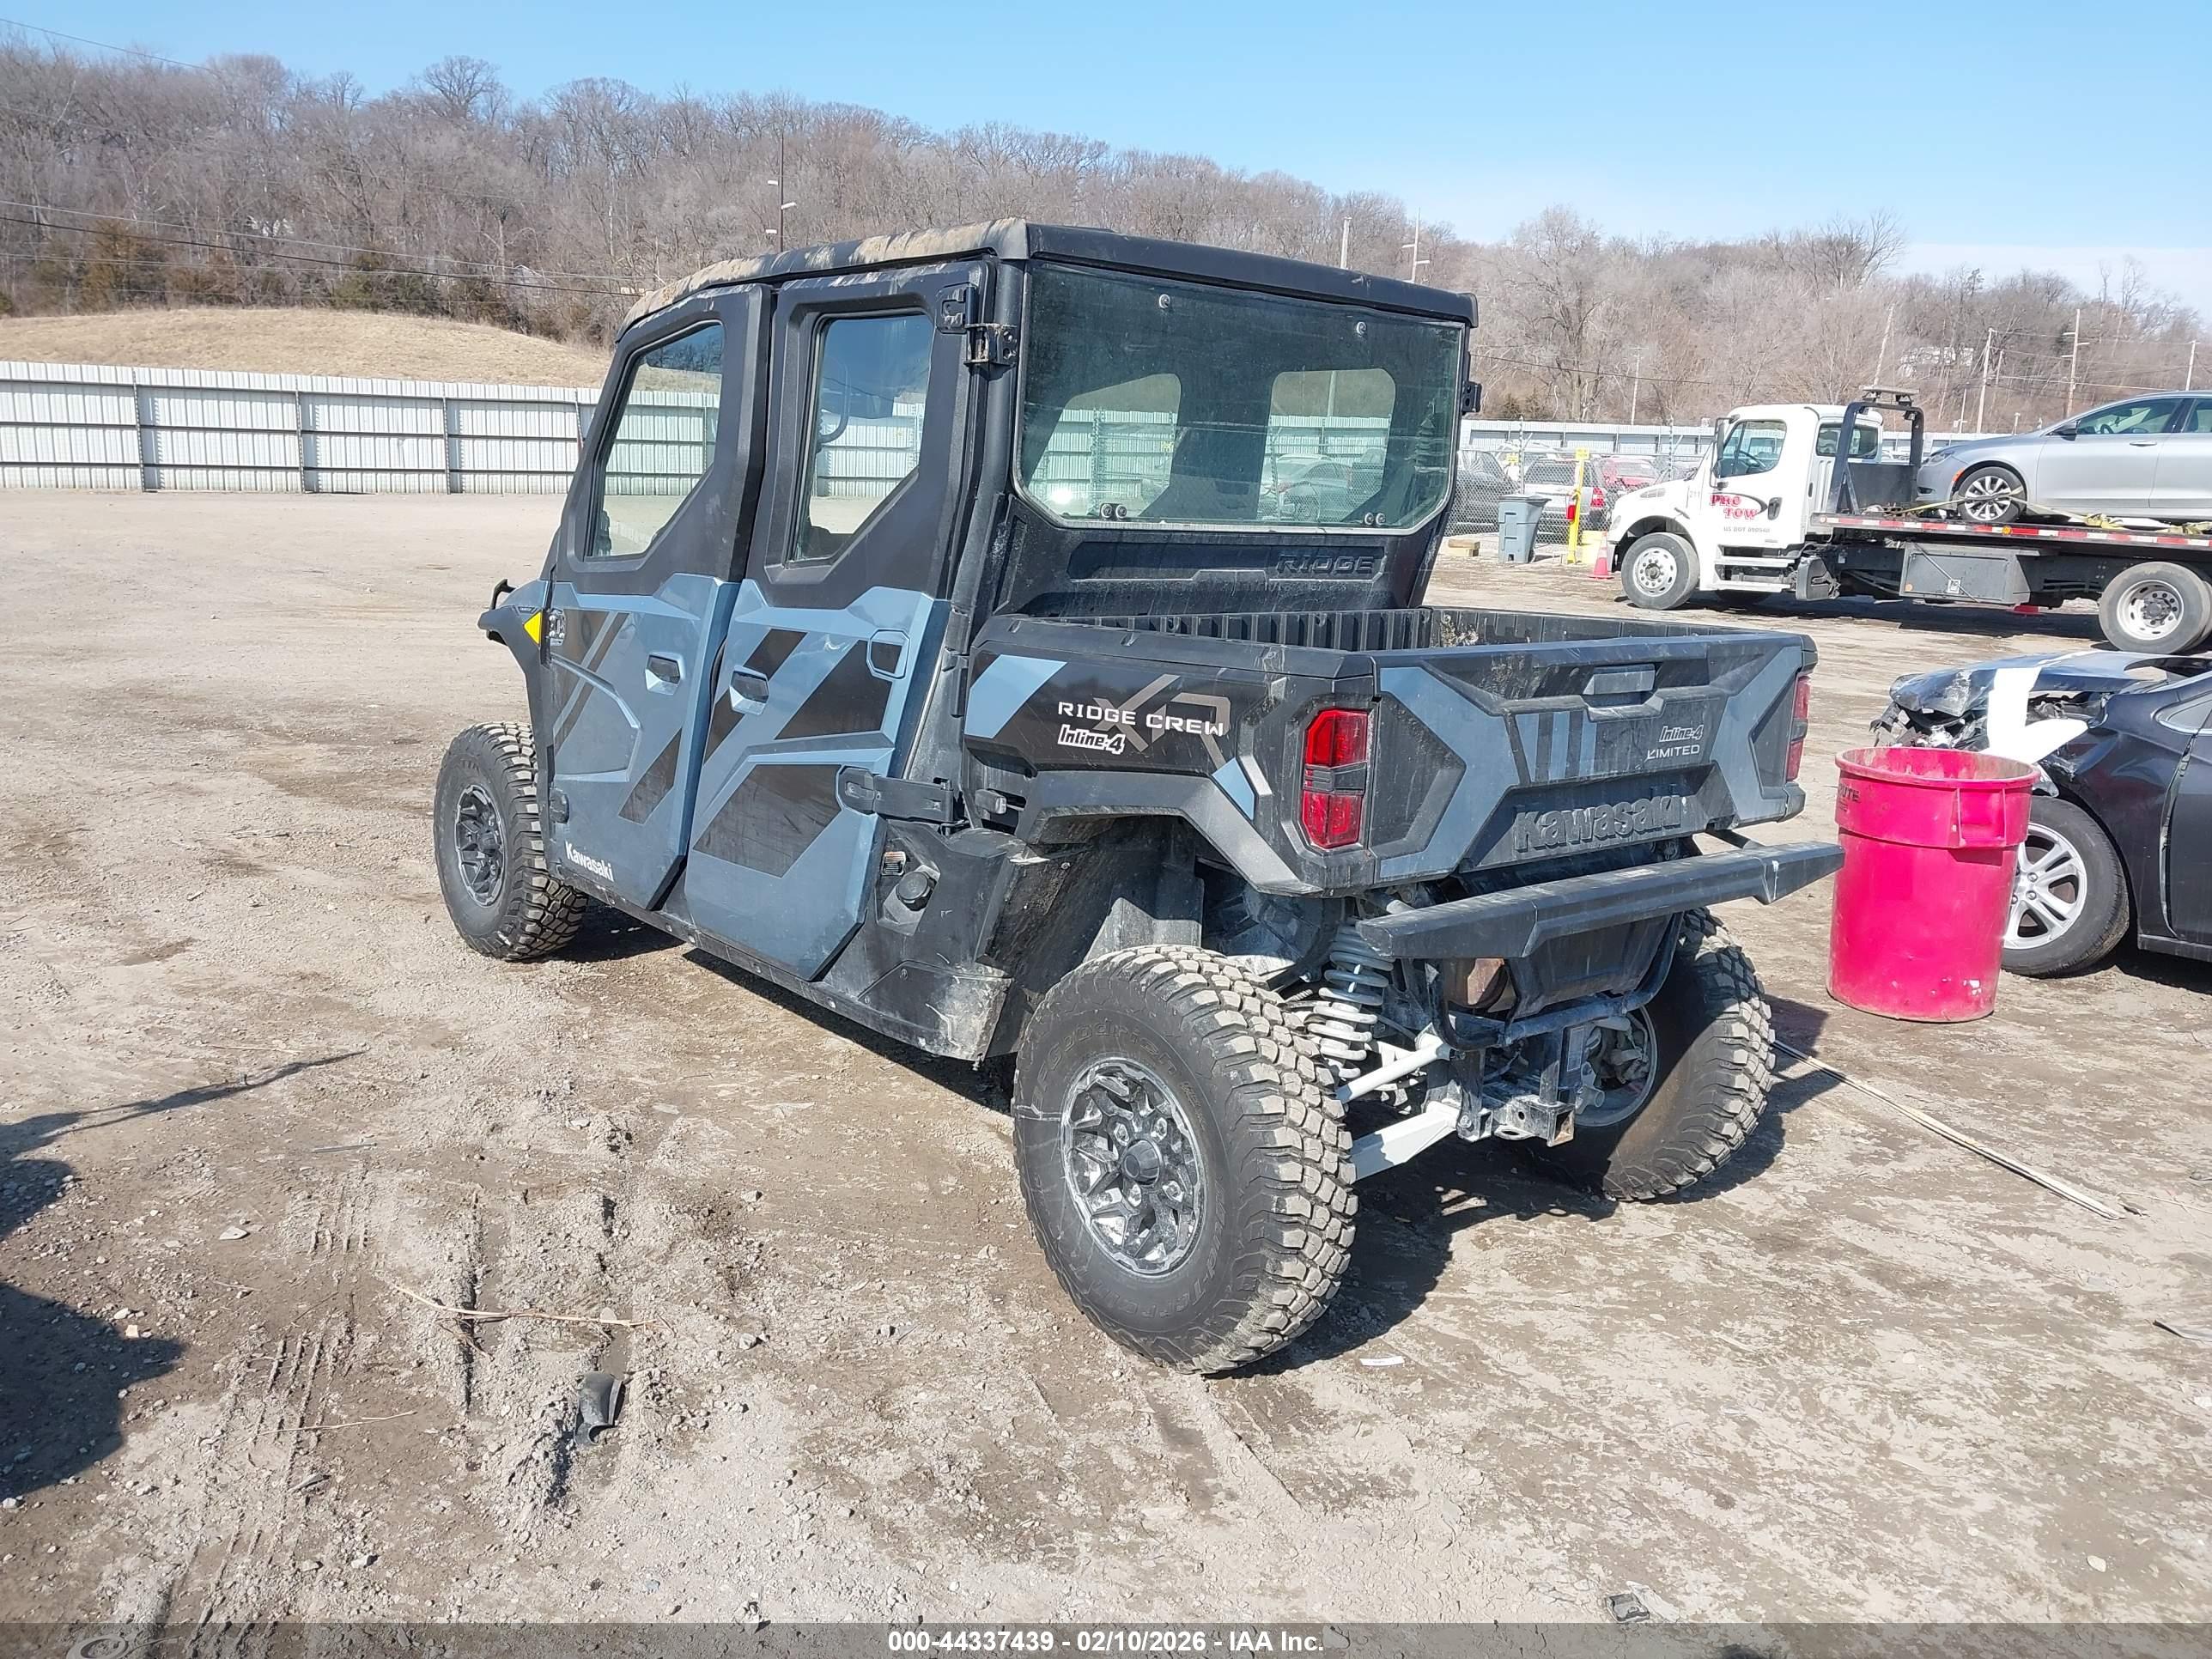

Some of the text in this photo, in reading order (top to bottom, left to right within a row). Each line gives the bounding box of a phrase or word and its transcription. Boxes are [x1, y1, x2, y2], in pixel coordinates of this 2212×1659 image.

[1710, 494, 1741, 507] PRO
[1723, 507, 1758, 520] TOW
[1276, 554, 1375, 573] RIDGE
[1058, 702, 1224, 737] RIDGE CREW
[1058, 724, 1127, 755] Inline-4
[1659, 724, 1705, 742] Inline-4
[1646, 744, 1700, 760] LIMITED
[1513, 795, 1682, 853] Kawasaki
[564, 841, 614, 882] Kawasaki
